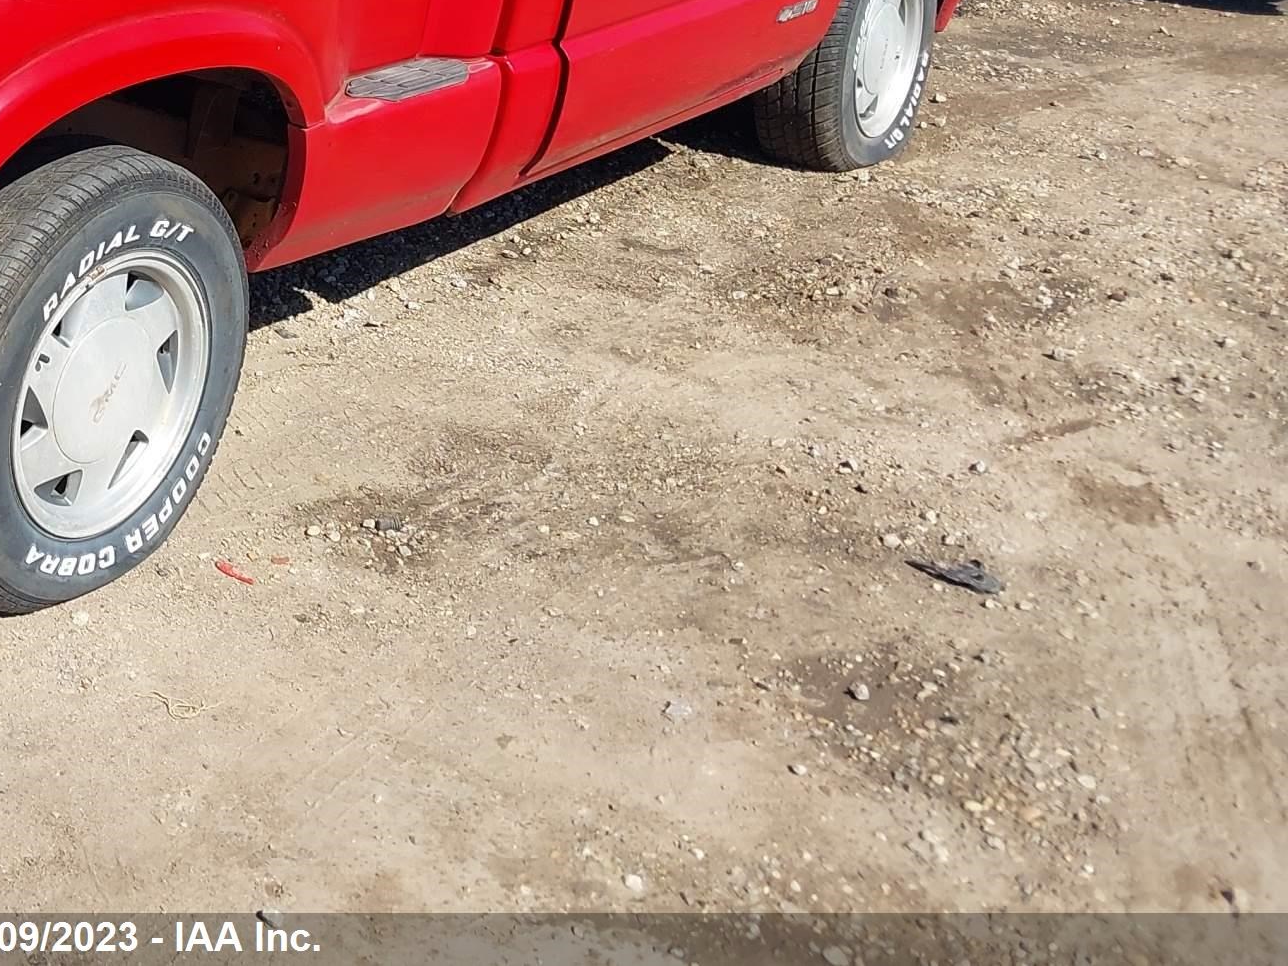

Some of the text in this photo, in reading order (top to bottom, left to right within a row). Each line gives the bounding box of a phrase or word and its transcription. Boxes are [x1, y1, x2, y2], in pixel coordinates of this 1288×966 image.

[43, 219, 194, 322] RADIAL G/T
[25, 432, 211, 576] COOPER COBRA
